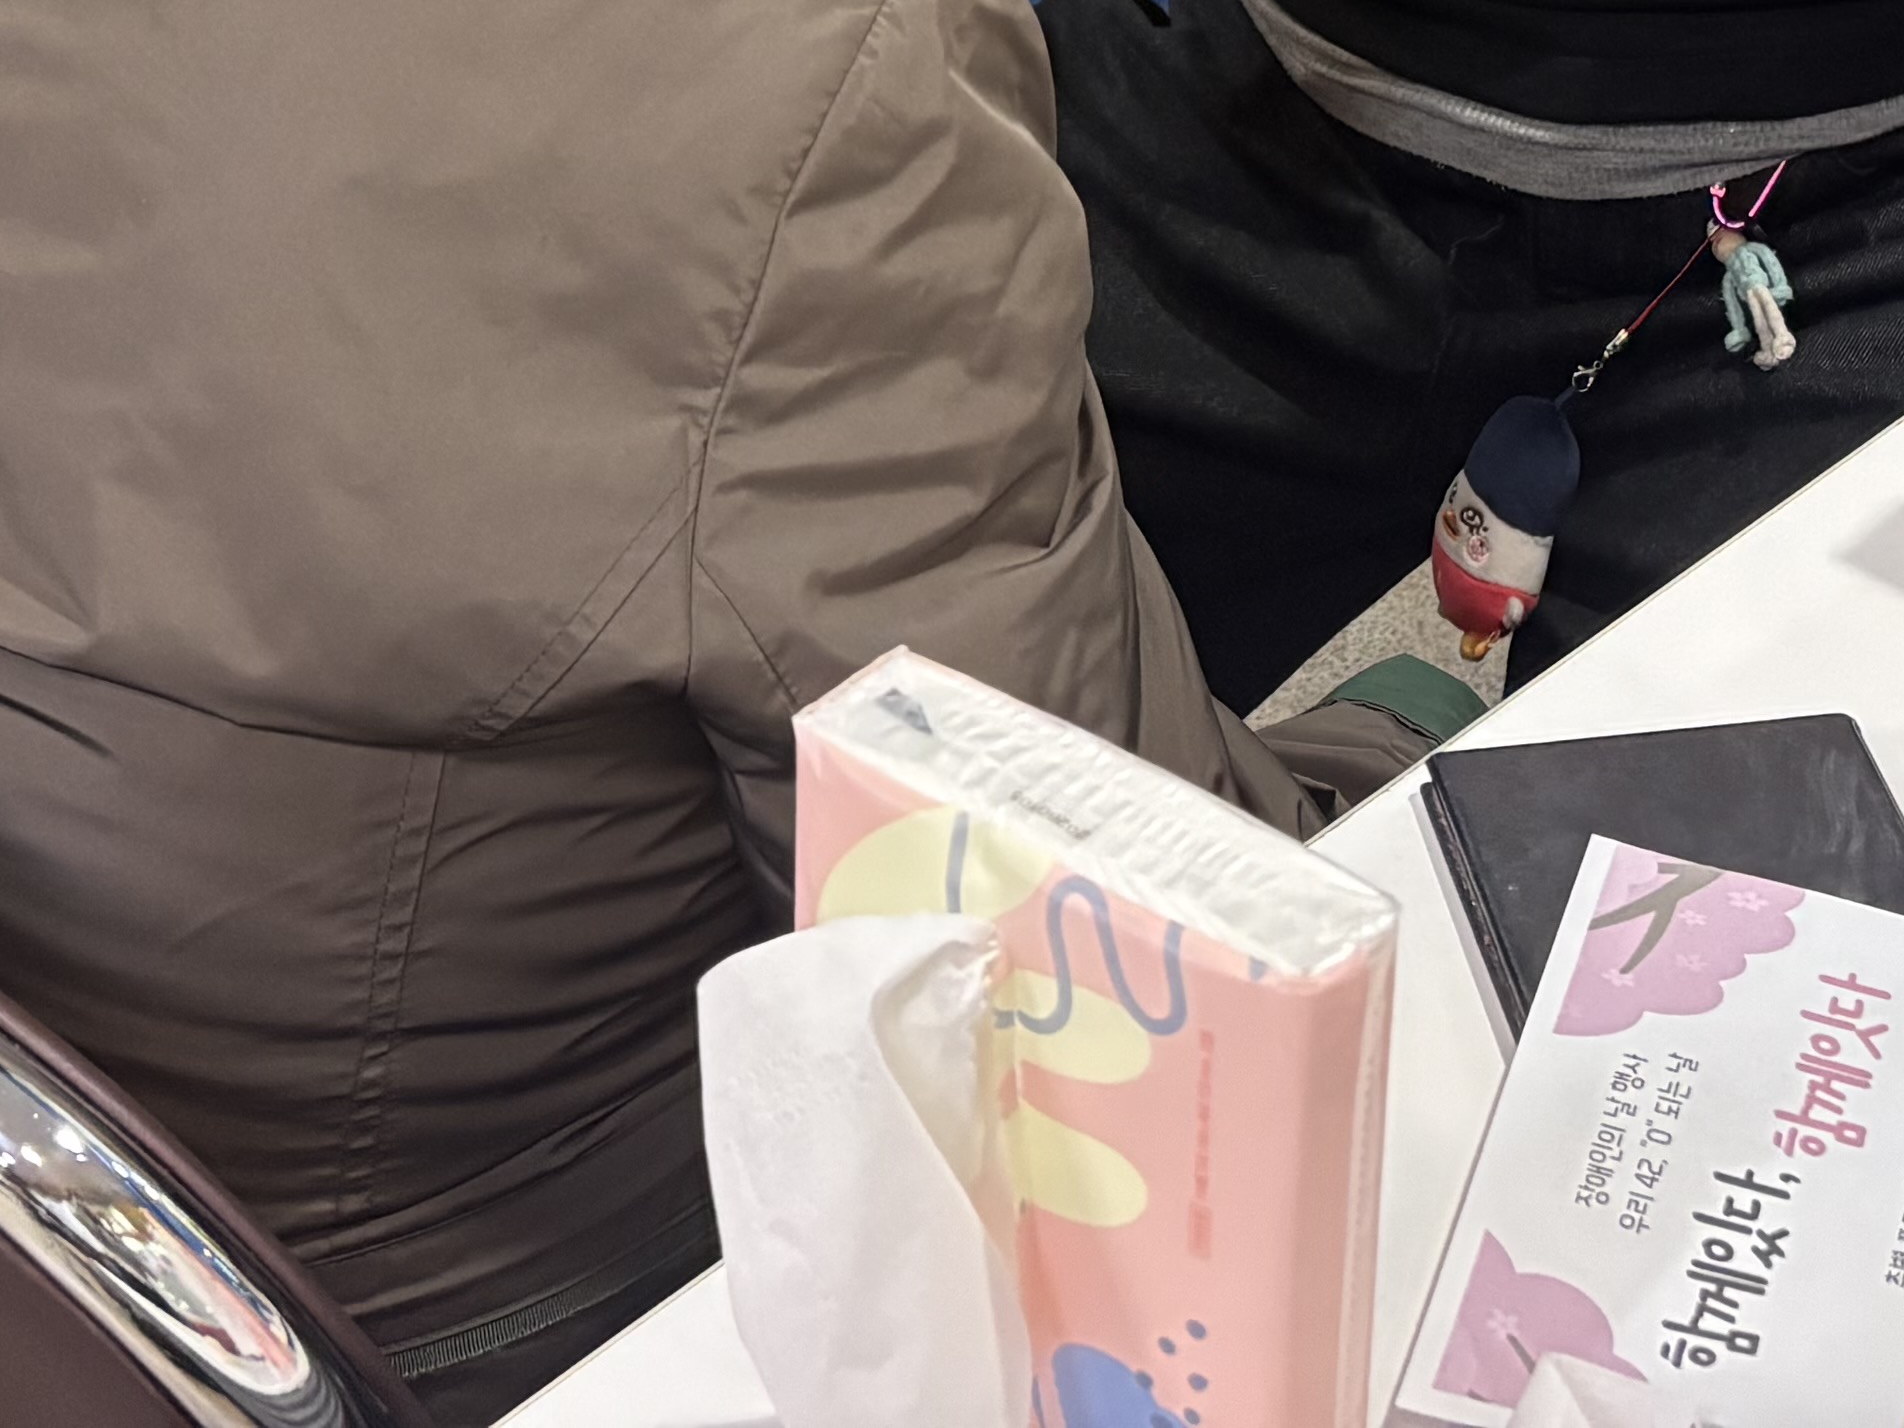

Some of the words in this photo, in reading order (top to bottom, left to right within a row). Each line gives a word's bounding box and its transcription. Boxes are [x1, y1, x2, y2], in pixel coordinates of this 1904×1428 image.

[1611, 1052, 1649, 1091] 행사
[1667, 1052, 1700, 1077] 날
[1603, 1096, 1638, 1120] 날
[1654, 1081, 1692, 1120] 되는
[1575, 1120, 1628, 1208] 장애인의
[1634, 1158, 1670, 1191] 42,
[1659, 1168, 1802, 1370] 함께있다,
[1771, 971, 1892, 1158] 함께잇다
[1618, 1185, 1656, 1235] 우리
